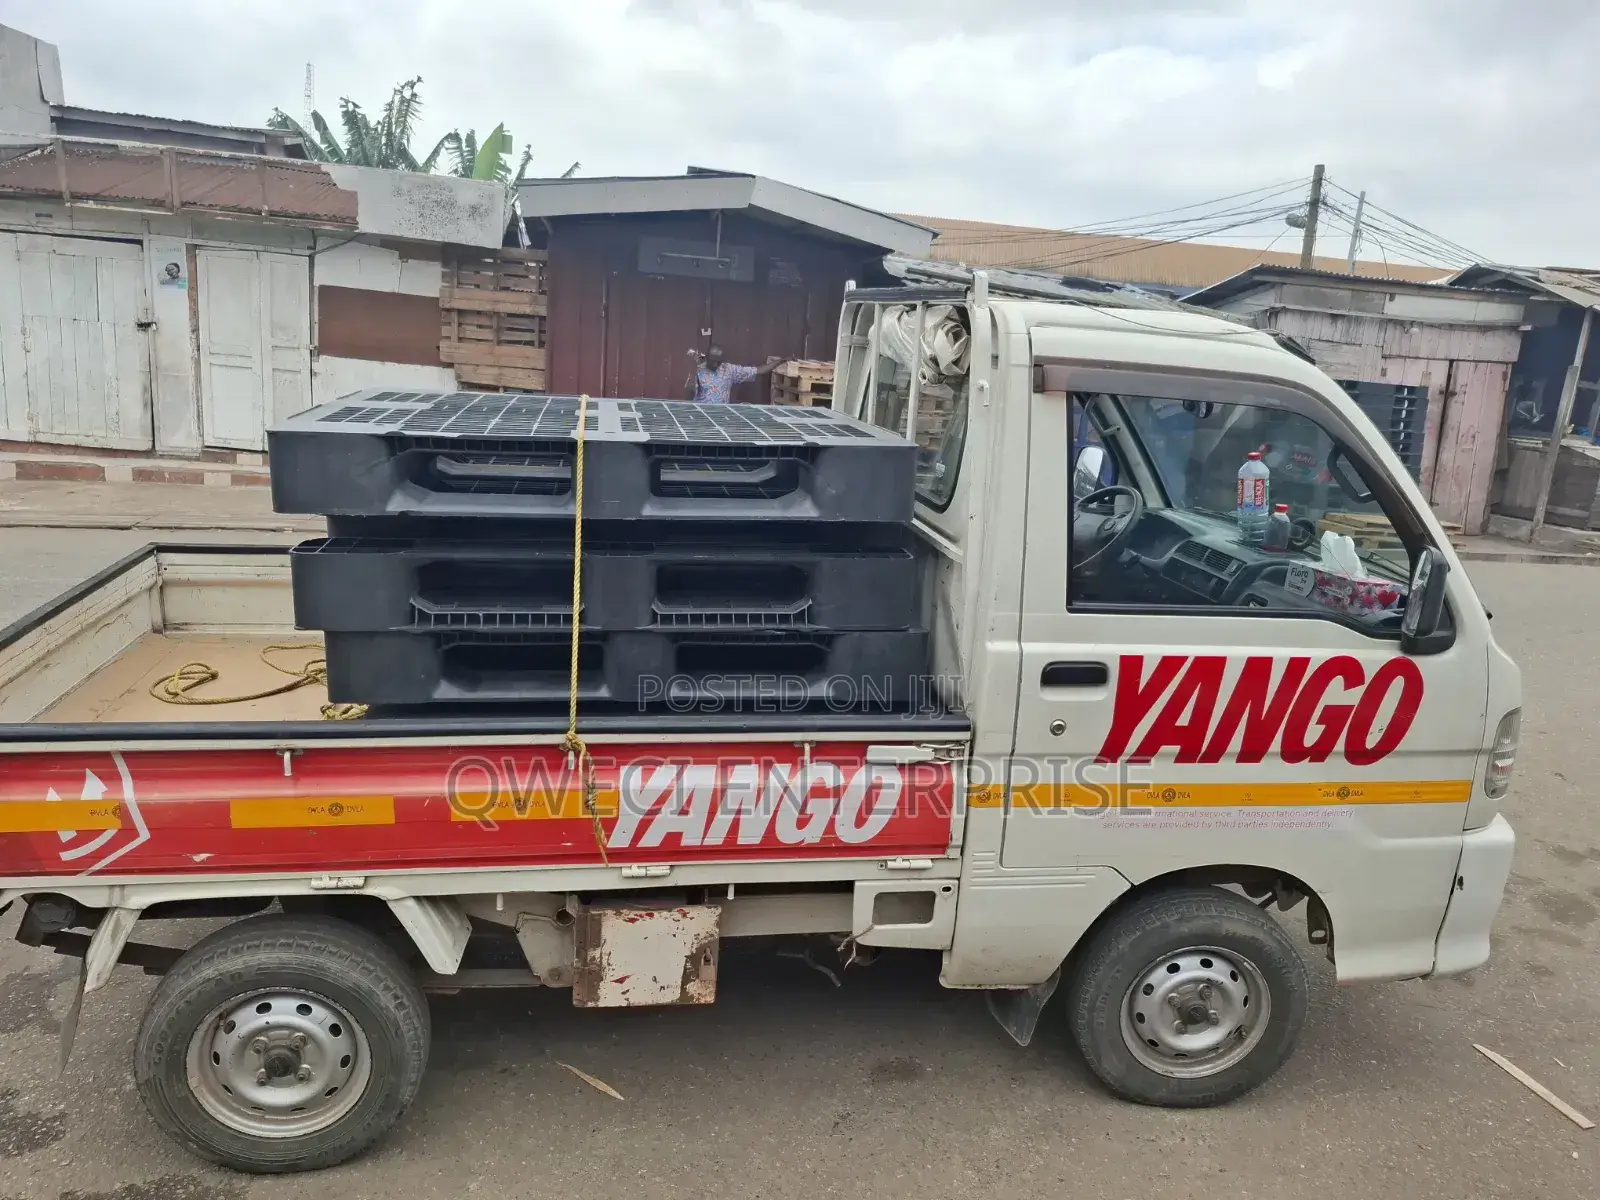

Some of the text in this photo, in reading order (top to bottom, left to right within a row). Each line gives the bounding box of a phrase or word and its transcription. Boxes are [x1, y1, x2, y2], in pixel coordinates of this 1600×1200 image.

[1092, 655, 1425, 766] YANGO
[606, 761, 902, 847] YANGO
[1102, 820, 1140, 829] services
[1142, 821, 1157, 829] are
[1159, 819, 1199, 831] provided
[1201, 819, 1213, 831] by
[1215, 819, 1236, 829] third
[1238, 818, 1268, 830] parties
[1238, 808, 1300, 819] Transportation
[1302, 808, 1319, 818] and
[1321, 807, 1354, 819] delivery
